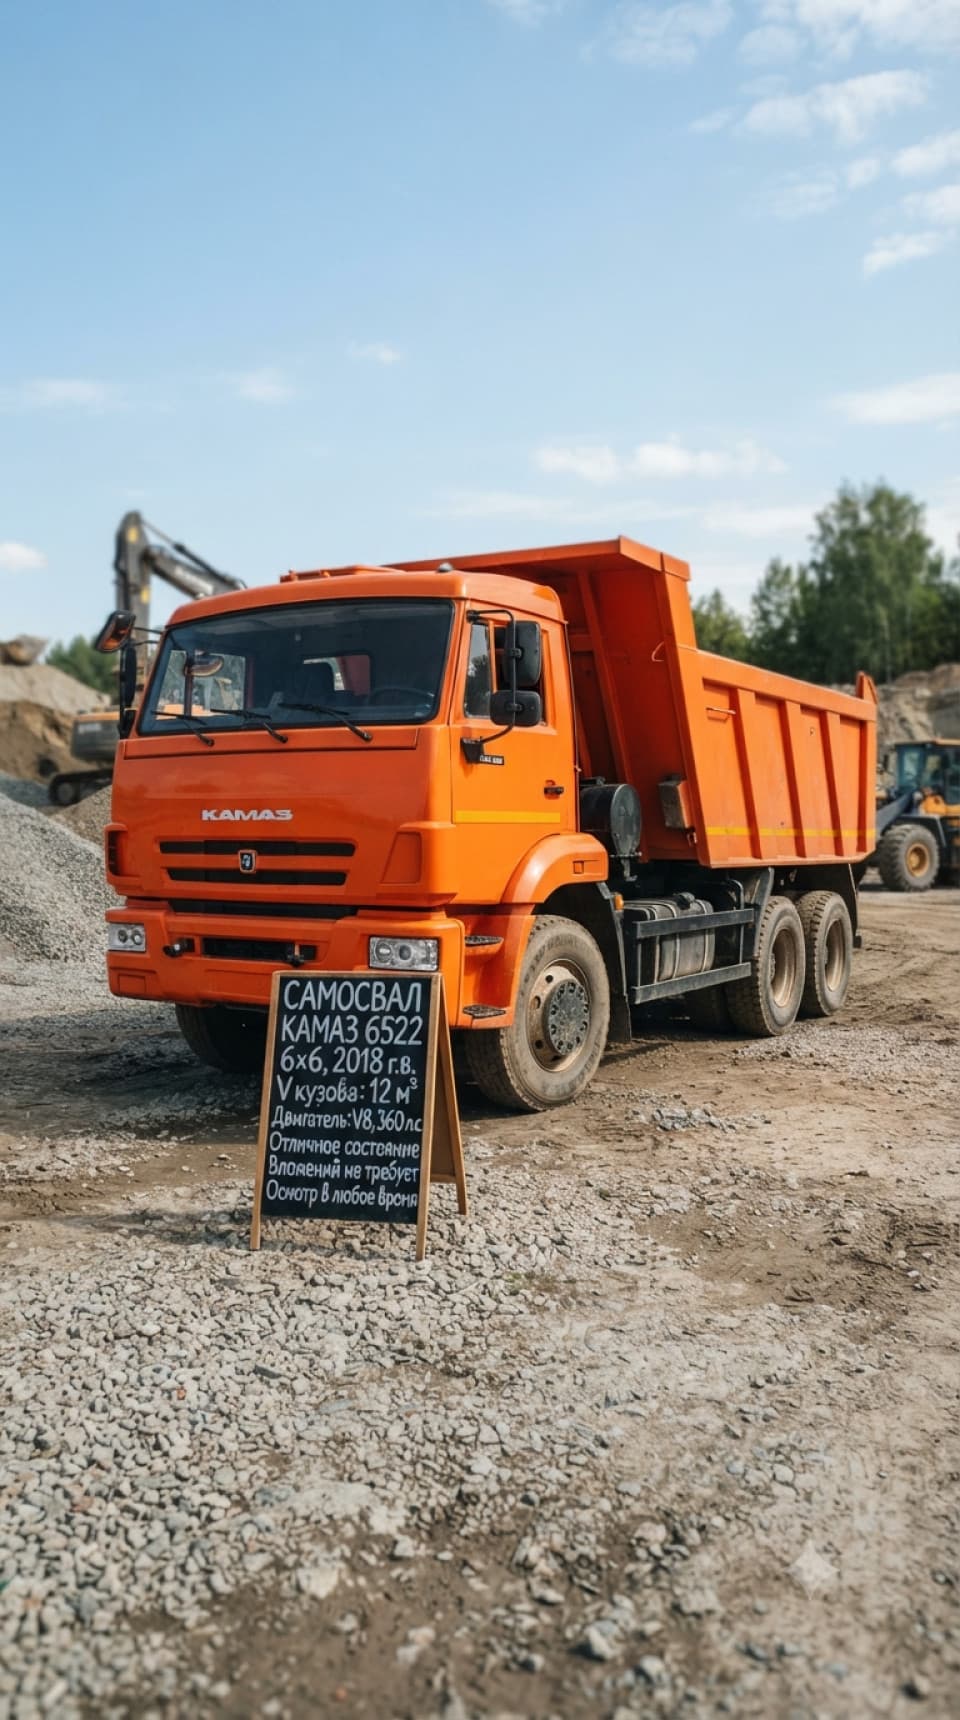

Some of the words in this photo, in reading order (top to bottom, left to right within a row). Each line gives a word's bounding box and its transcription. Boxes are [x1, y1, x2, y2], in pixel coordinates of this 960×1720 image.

[283, 979, 422, 1013] САМОСВАЛ
[281, 1014, 359, 1044] КАМАЗ
[365, 1015, 424, 1046] 6522
[332, 1046, 384, 1074] 2018
[369, 1076, 391, 1104] 12
[332, 1184, 375, 1205] любое
